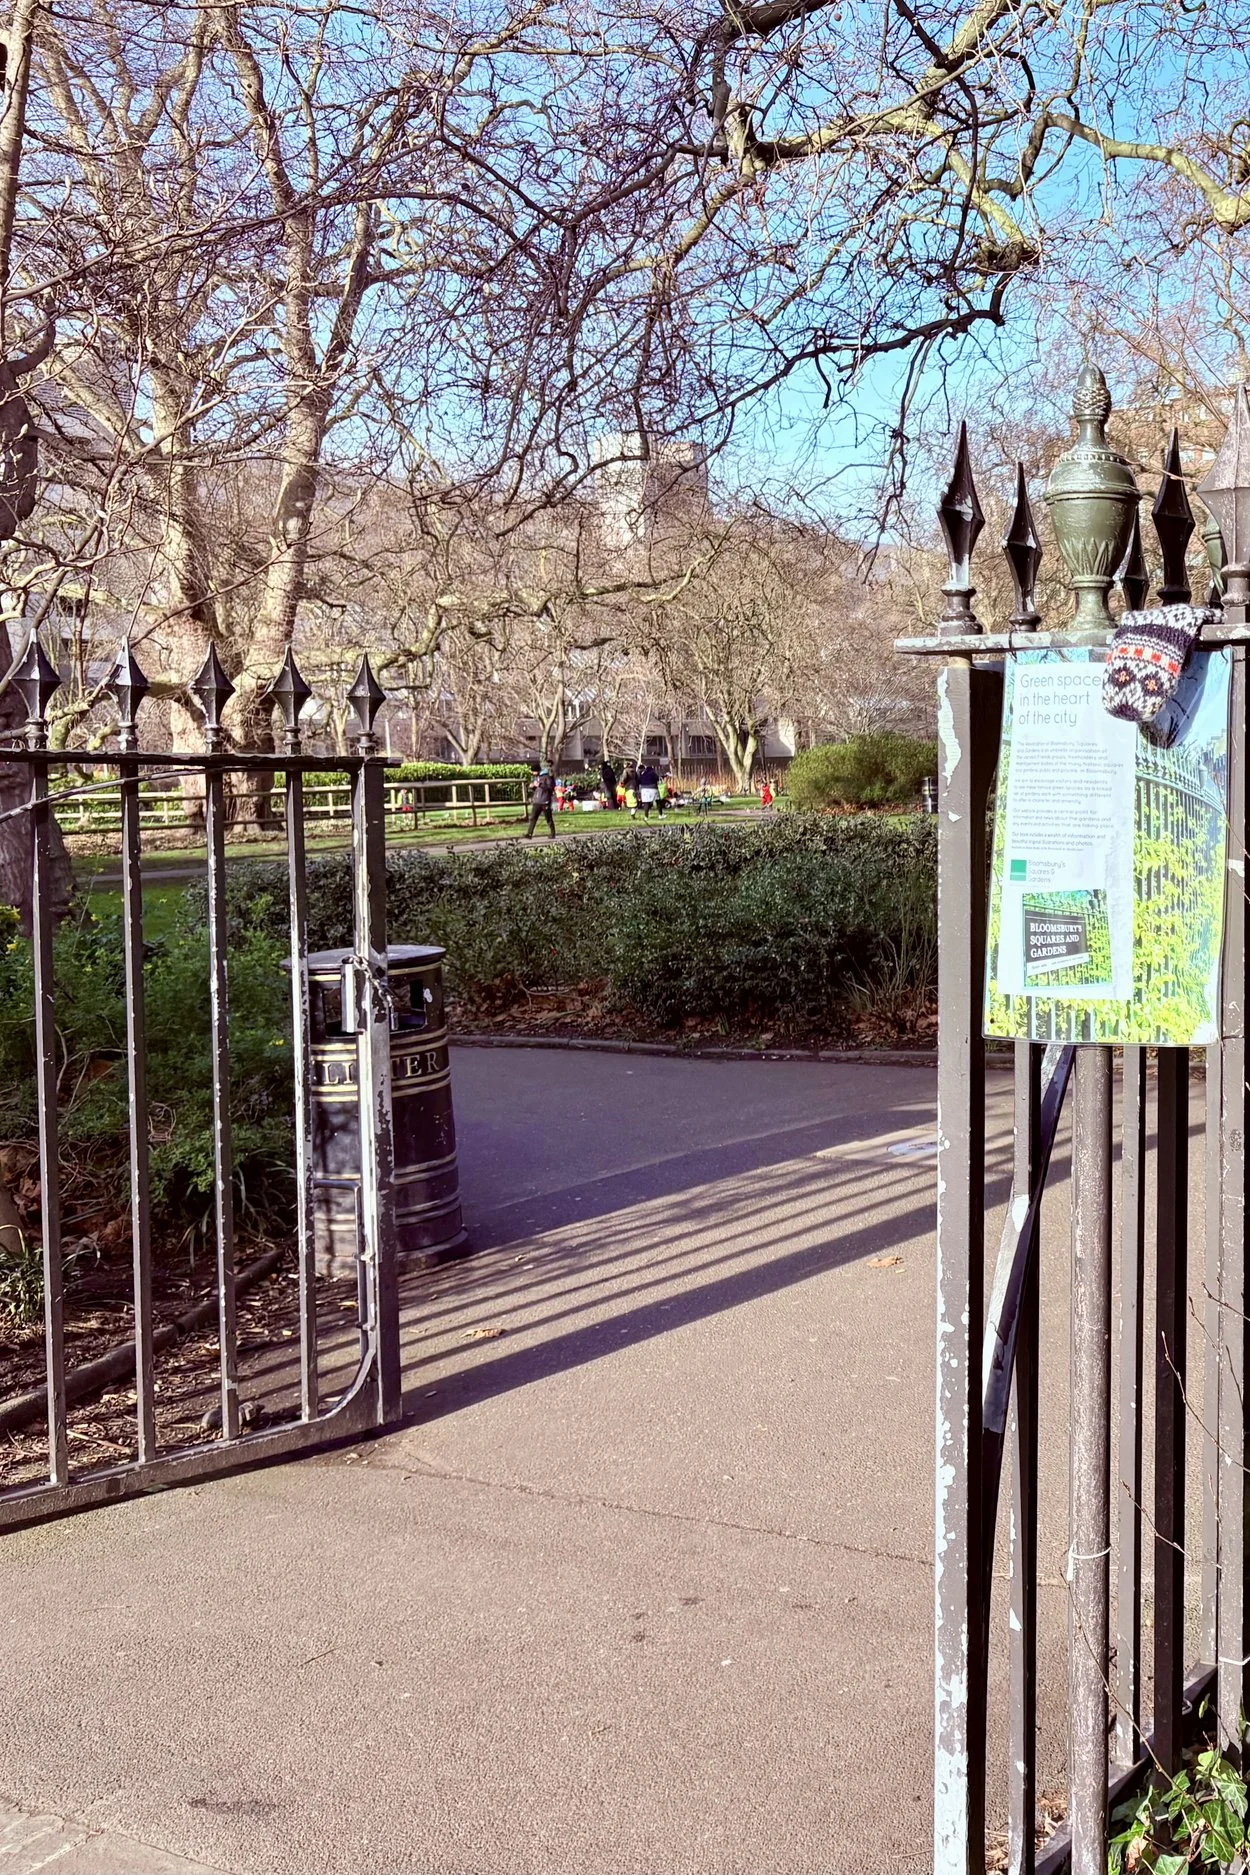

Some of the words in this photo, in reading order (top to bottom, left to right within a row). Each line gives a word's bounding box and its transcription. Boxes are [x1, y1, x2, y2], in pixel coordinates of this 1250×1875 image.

[1020, 673, 1054, 688] Green
[1019, 692, 1030, 706] in
[1033, 691, 1051, 706] the
[1053, 690, 1090, 705] heart
[1018, 709, 1030, 725] of
[1033, 709, 1051, 724] the
[1053, 709, 1077, 727] city
[1028, 859, 1066, 868] Boomsbury's
[1029, 922, 1083, 932] BLOOMSBURY'S
[1030, 935, 1065, 946] SQUARES
[1065, 934, 1080, 943] AND
[1030, 945, 1067, 958] GARDENS
[322, 1051, 440, 1084] LITER
